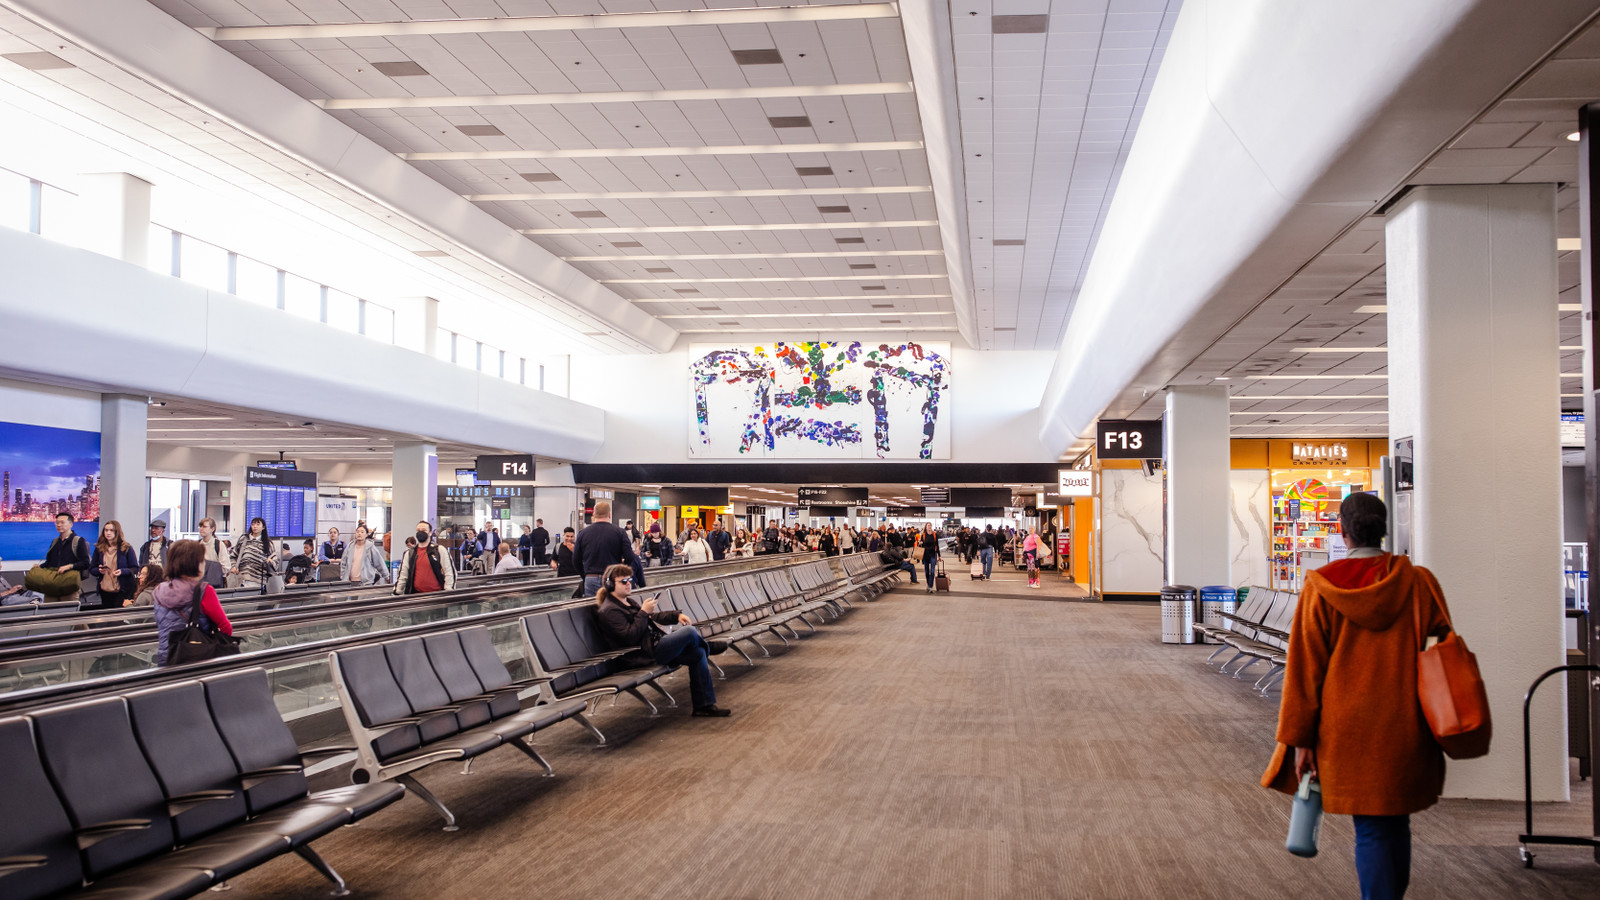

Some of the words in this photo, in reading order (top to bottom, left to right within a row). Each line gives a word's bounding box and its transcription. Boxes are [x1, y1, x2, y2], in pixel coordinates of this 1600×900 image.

[1104, 431, 1143, 450] F13
[1293, 445, 1348, 458] NATALIE'S
[502, 462, 528, 475] F14
[447, 487, 489, 497] KLEIN'S
[495, 487, 521, 496] DELI
